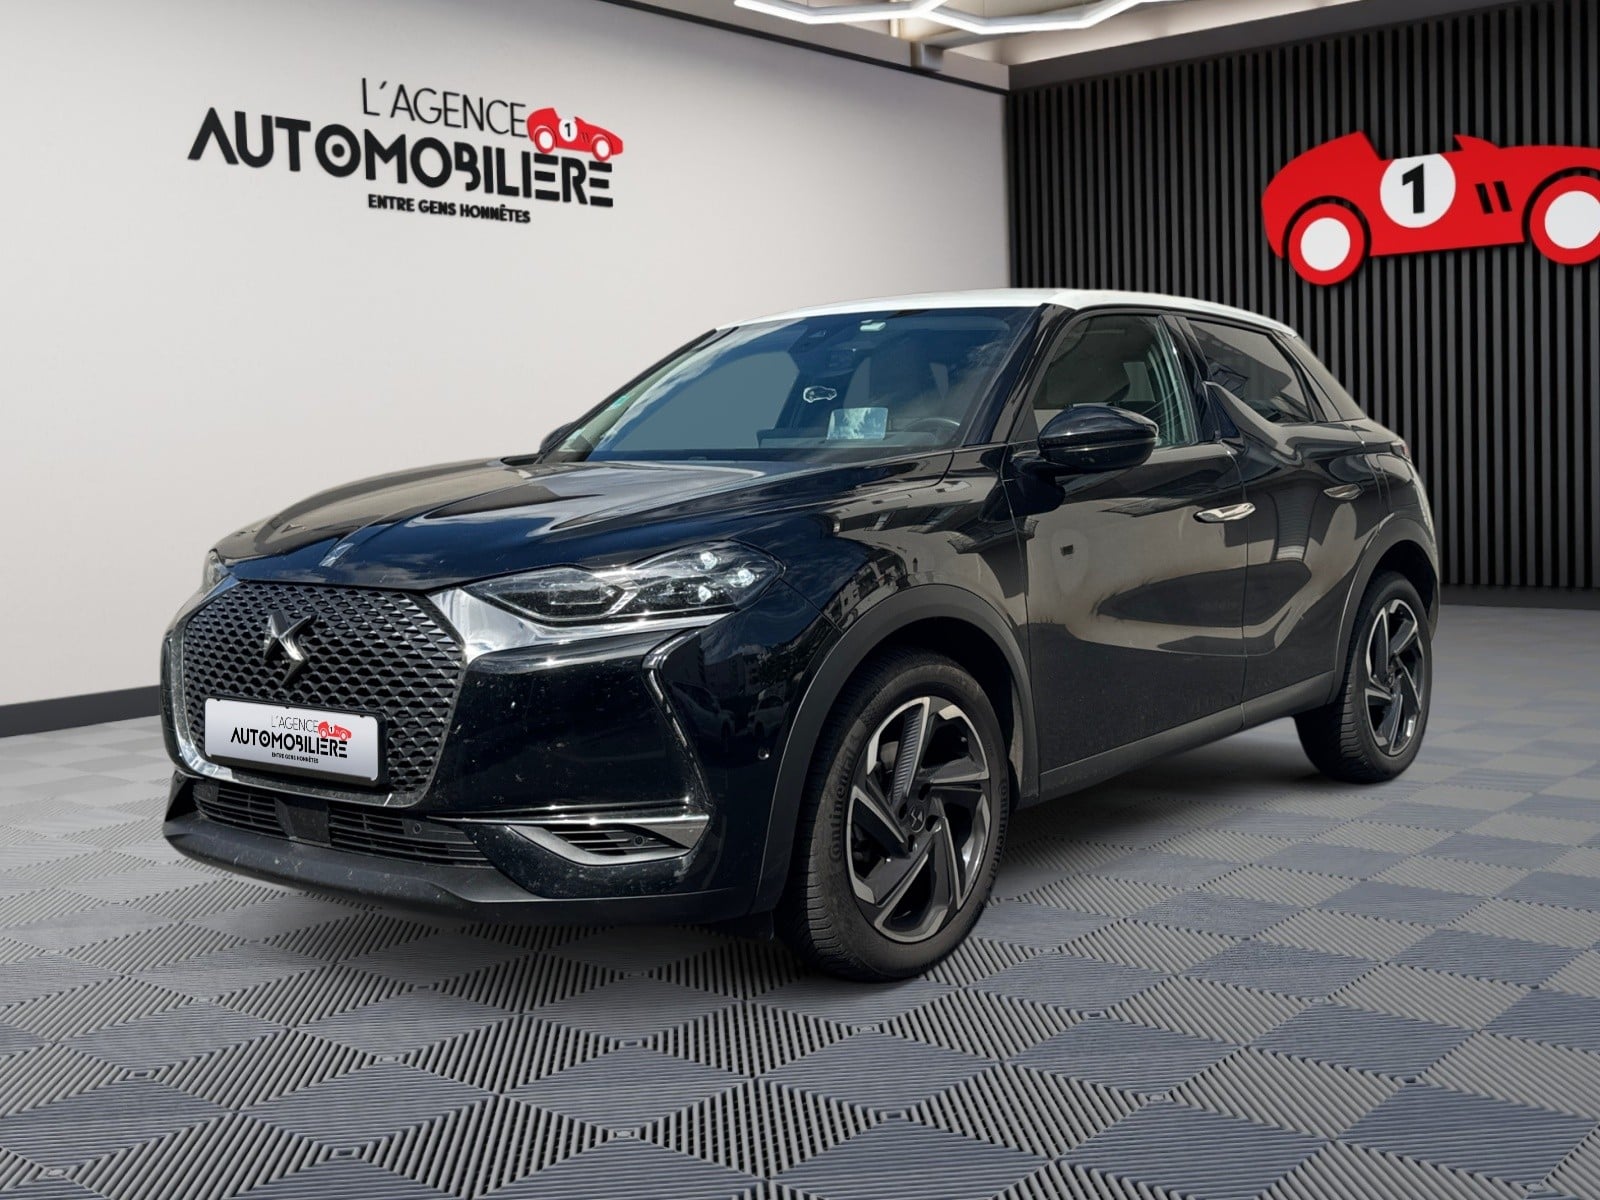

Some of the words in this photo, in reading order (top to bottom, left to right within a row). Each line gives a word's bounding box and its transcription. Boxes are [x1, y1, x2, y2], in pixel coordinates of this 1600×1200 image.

[563, 122, 572, 138] 1
[1401, 162, 1426, 215] 1
[368, 193, 415, 212] ENTRE
[418, 199, 456, 216] GENS
[460, 204, 531, 224] HONNÊTES
